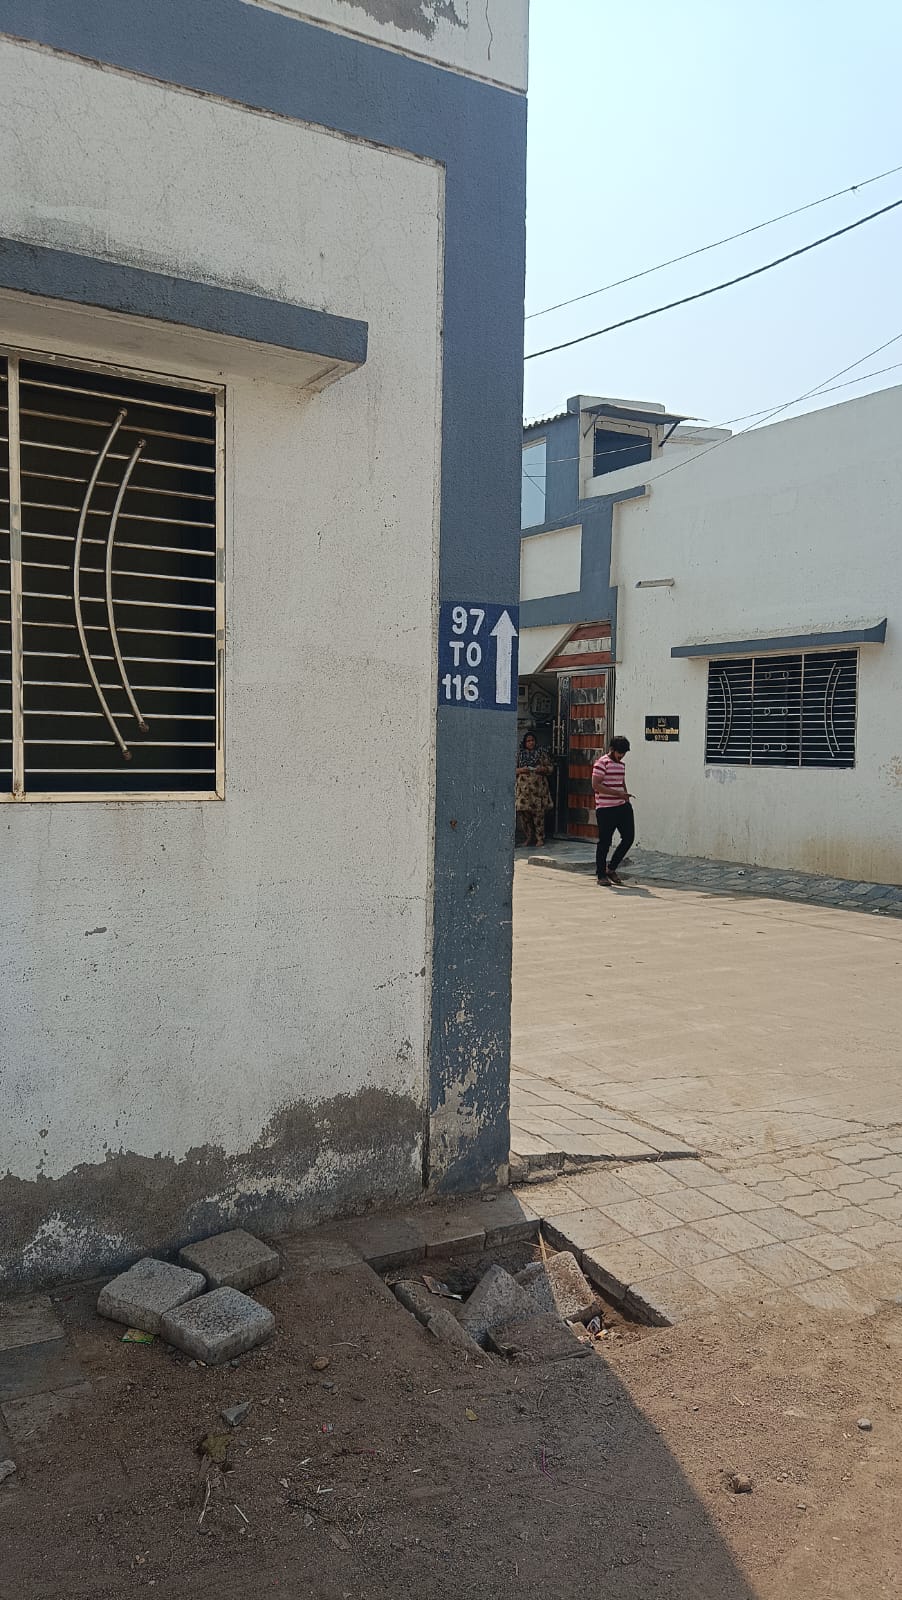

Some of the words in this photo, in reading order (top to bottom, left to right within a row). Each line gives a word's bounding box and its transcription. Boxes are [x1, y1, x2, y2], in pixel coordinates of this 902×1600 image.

[452, 606, 485, 635] 97
[449, 641, 482, 667] TO
[442, 674, 479, 701] 116
